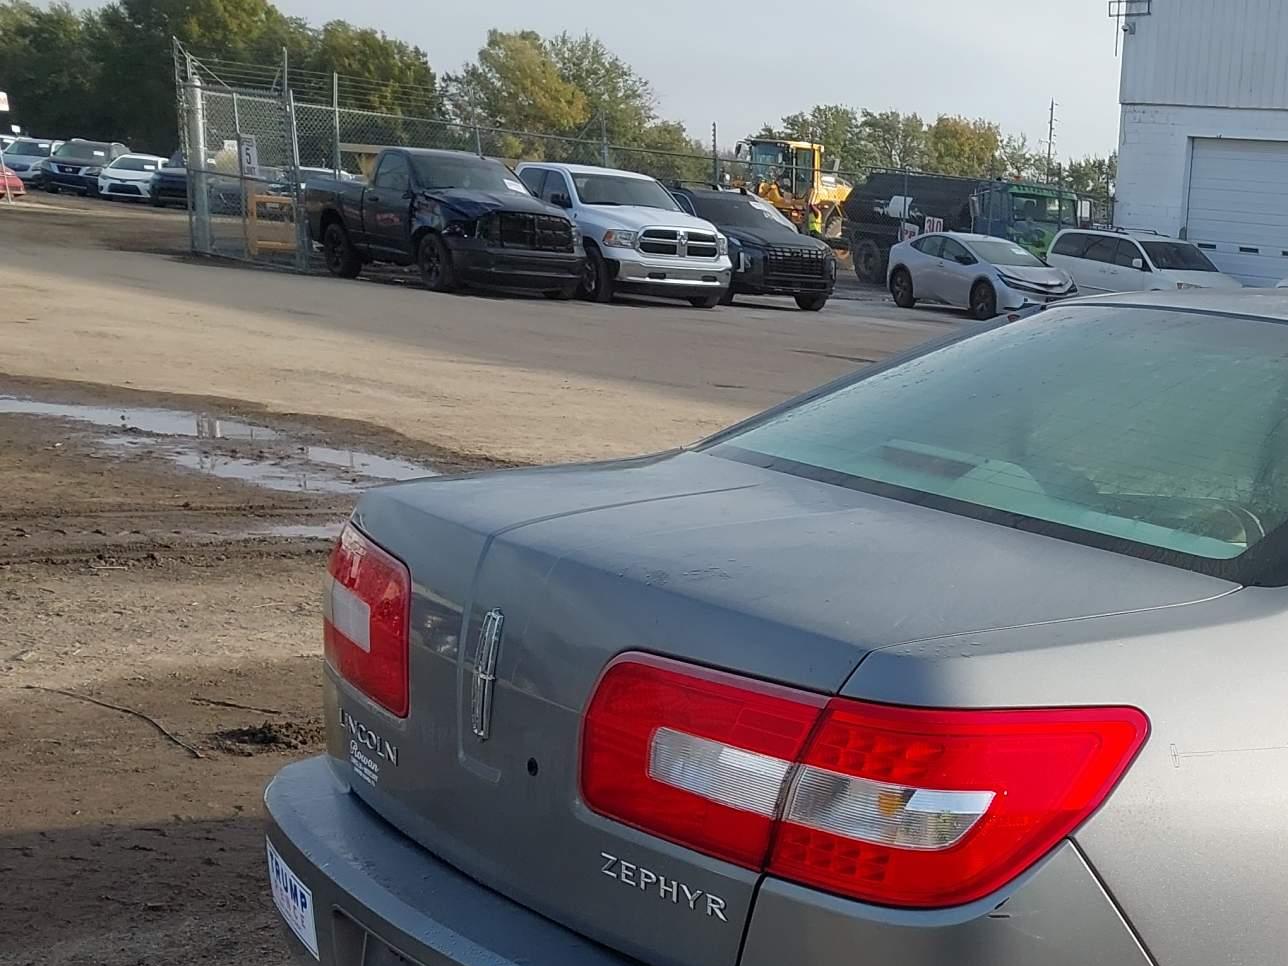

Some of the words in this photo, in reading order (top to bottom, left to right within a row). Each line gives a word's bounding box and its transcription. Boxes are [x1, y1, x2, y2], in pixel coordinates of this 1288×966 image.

[338, 707, 400, 768] LINCOLN
[269, 848, 308, 913] TRUMP
[600, 852, 728, 922] ZEPHYR
